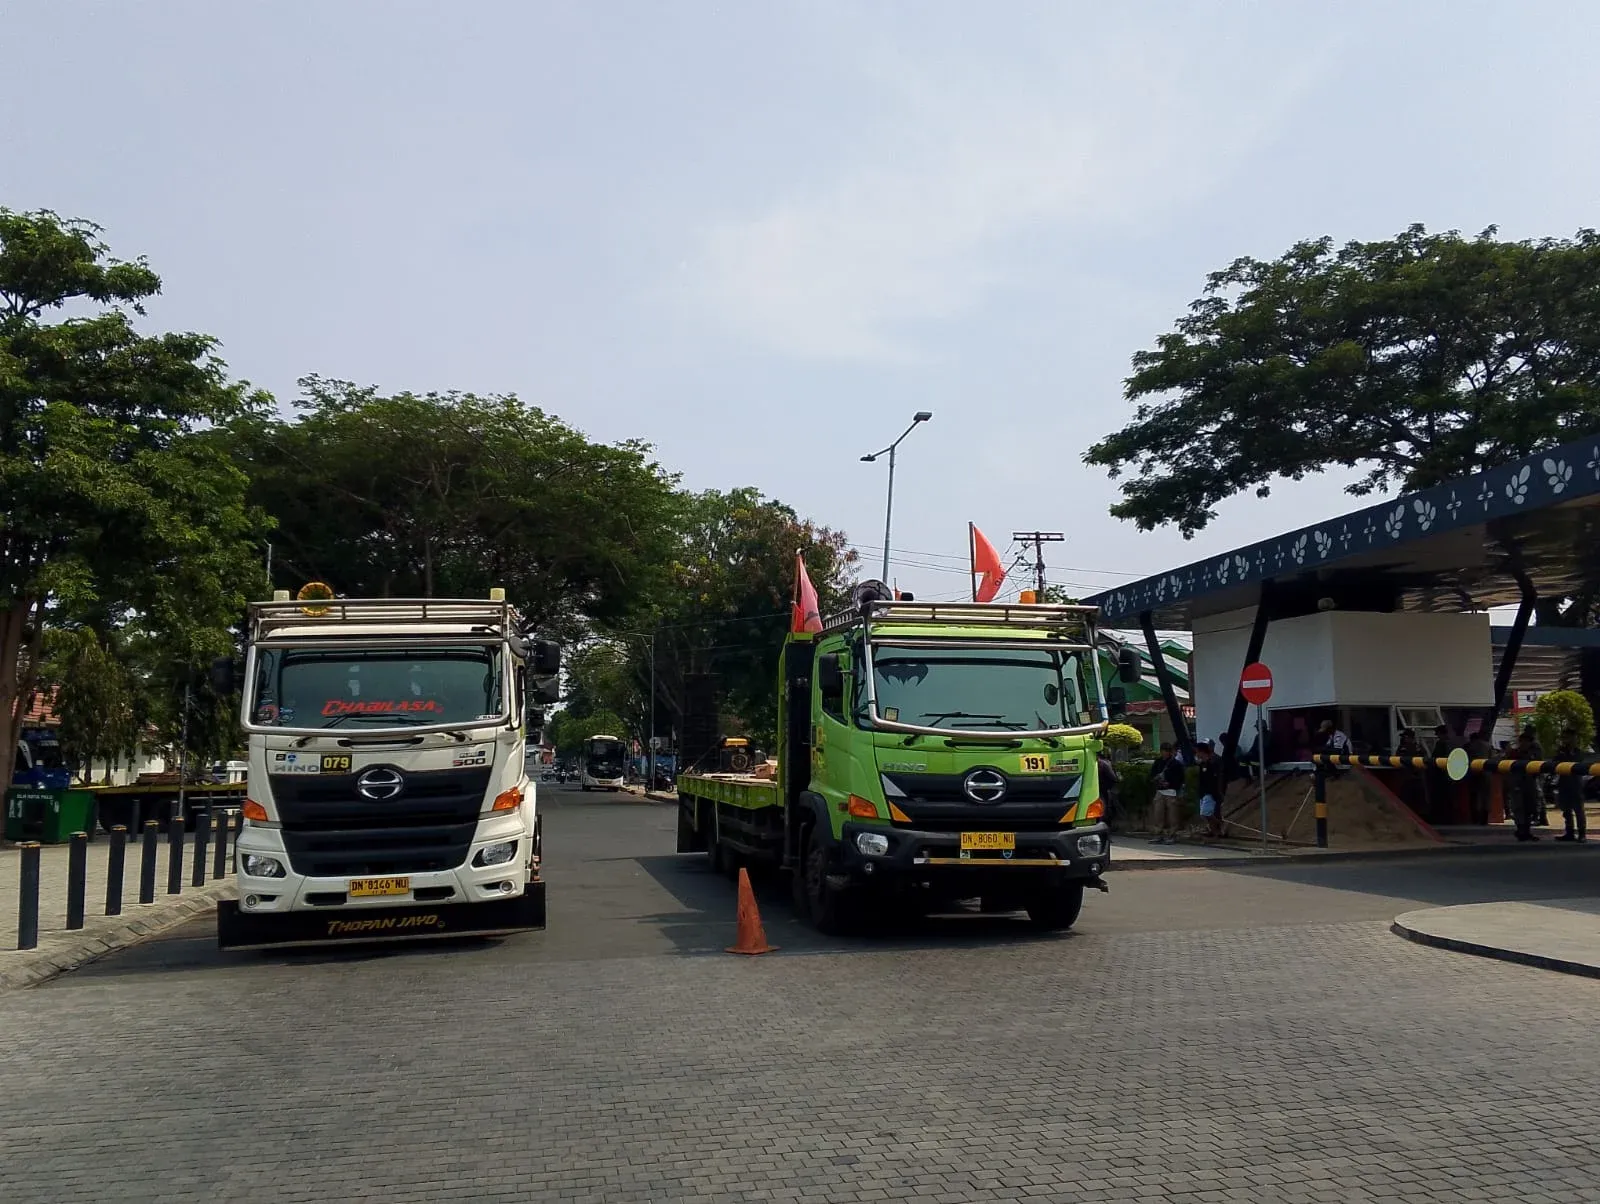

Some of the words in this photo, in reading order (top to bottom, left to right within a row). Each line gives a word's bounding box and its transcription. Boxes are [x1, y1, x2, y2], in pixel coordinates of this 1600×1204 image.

[323, 757, 349, 769] 079
[453, 758, 486, 766] 500
[1024, 757, 1045, 770] 191
[962, 834, 972, 843] DN
[352, 881, 364, 891] DN
[395, 878, 407, 889] NU
